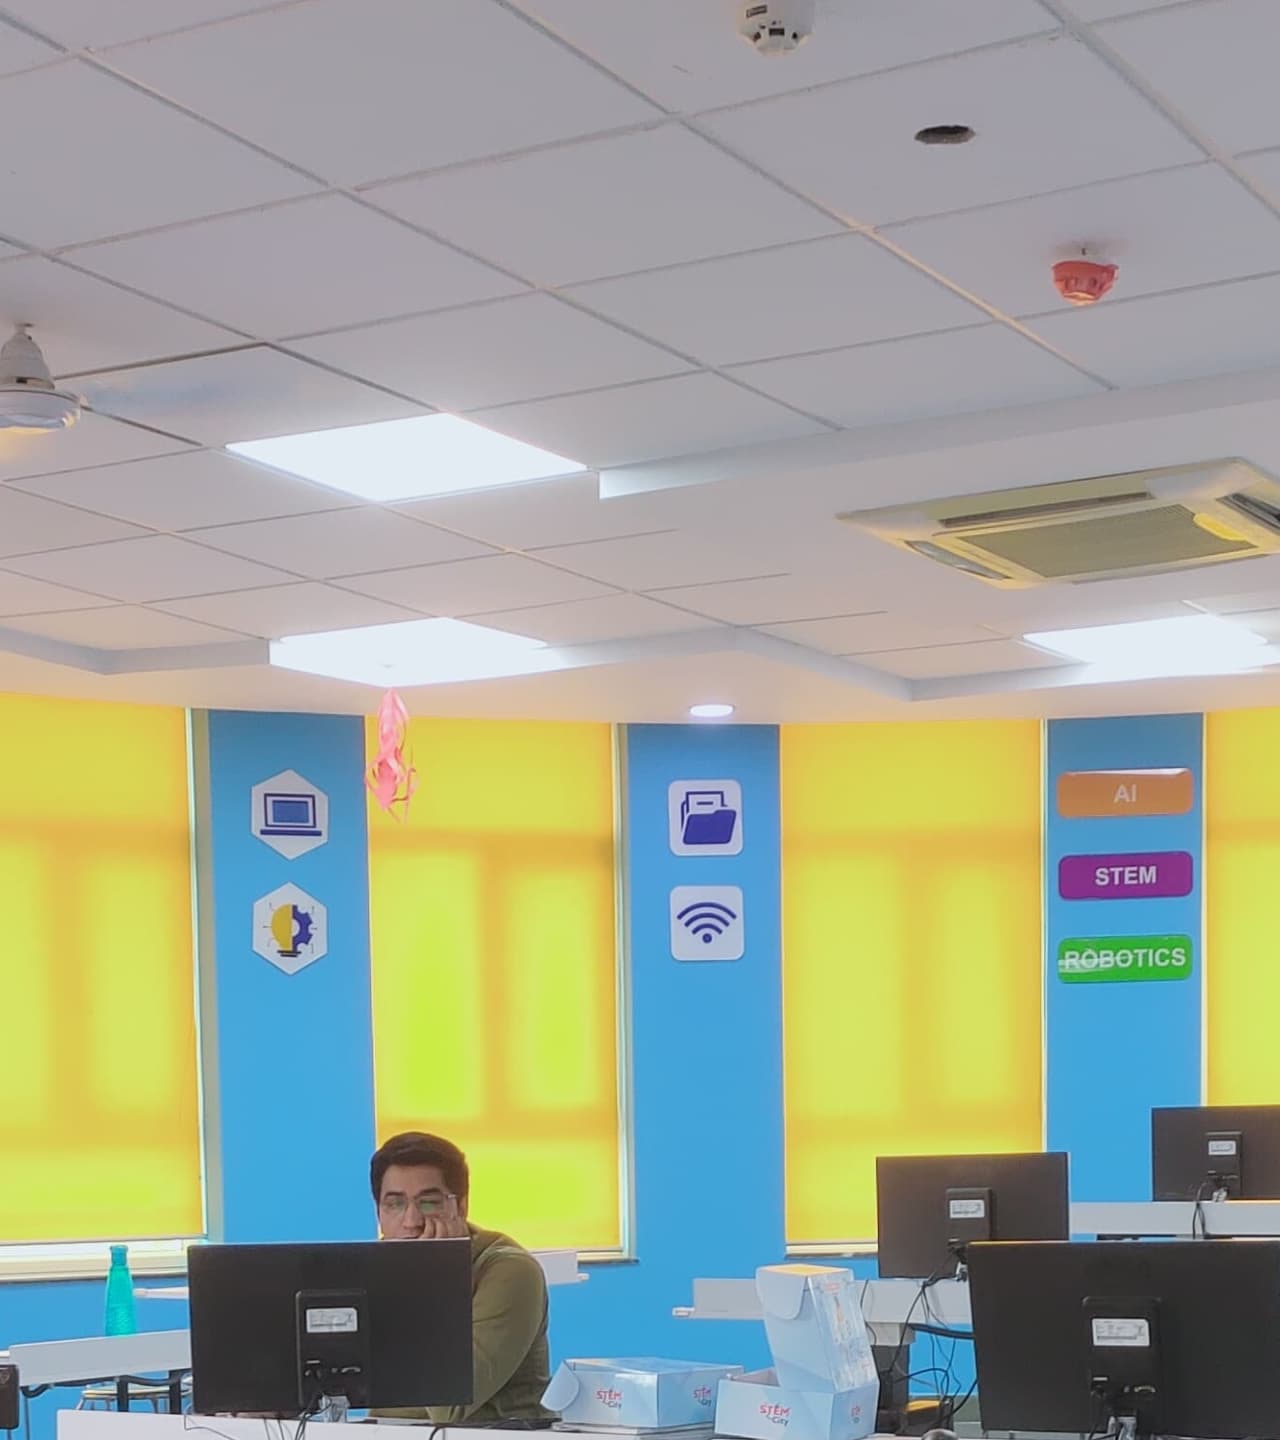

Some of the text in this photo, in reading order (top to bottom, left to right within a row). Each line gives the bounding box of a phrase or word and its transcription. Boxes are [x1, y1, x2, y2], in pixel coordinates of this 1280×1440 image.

[1113, 784, 1137, 803] AI
[1095, 866, 1157, 886] STEM
[1063, 948, 1186, 970] ROBOTICS
[759, 1405, 790, 1416] STEM
